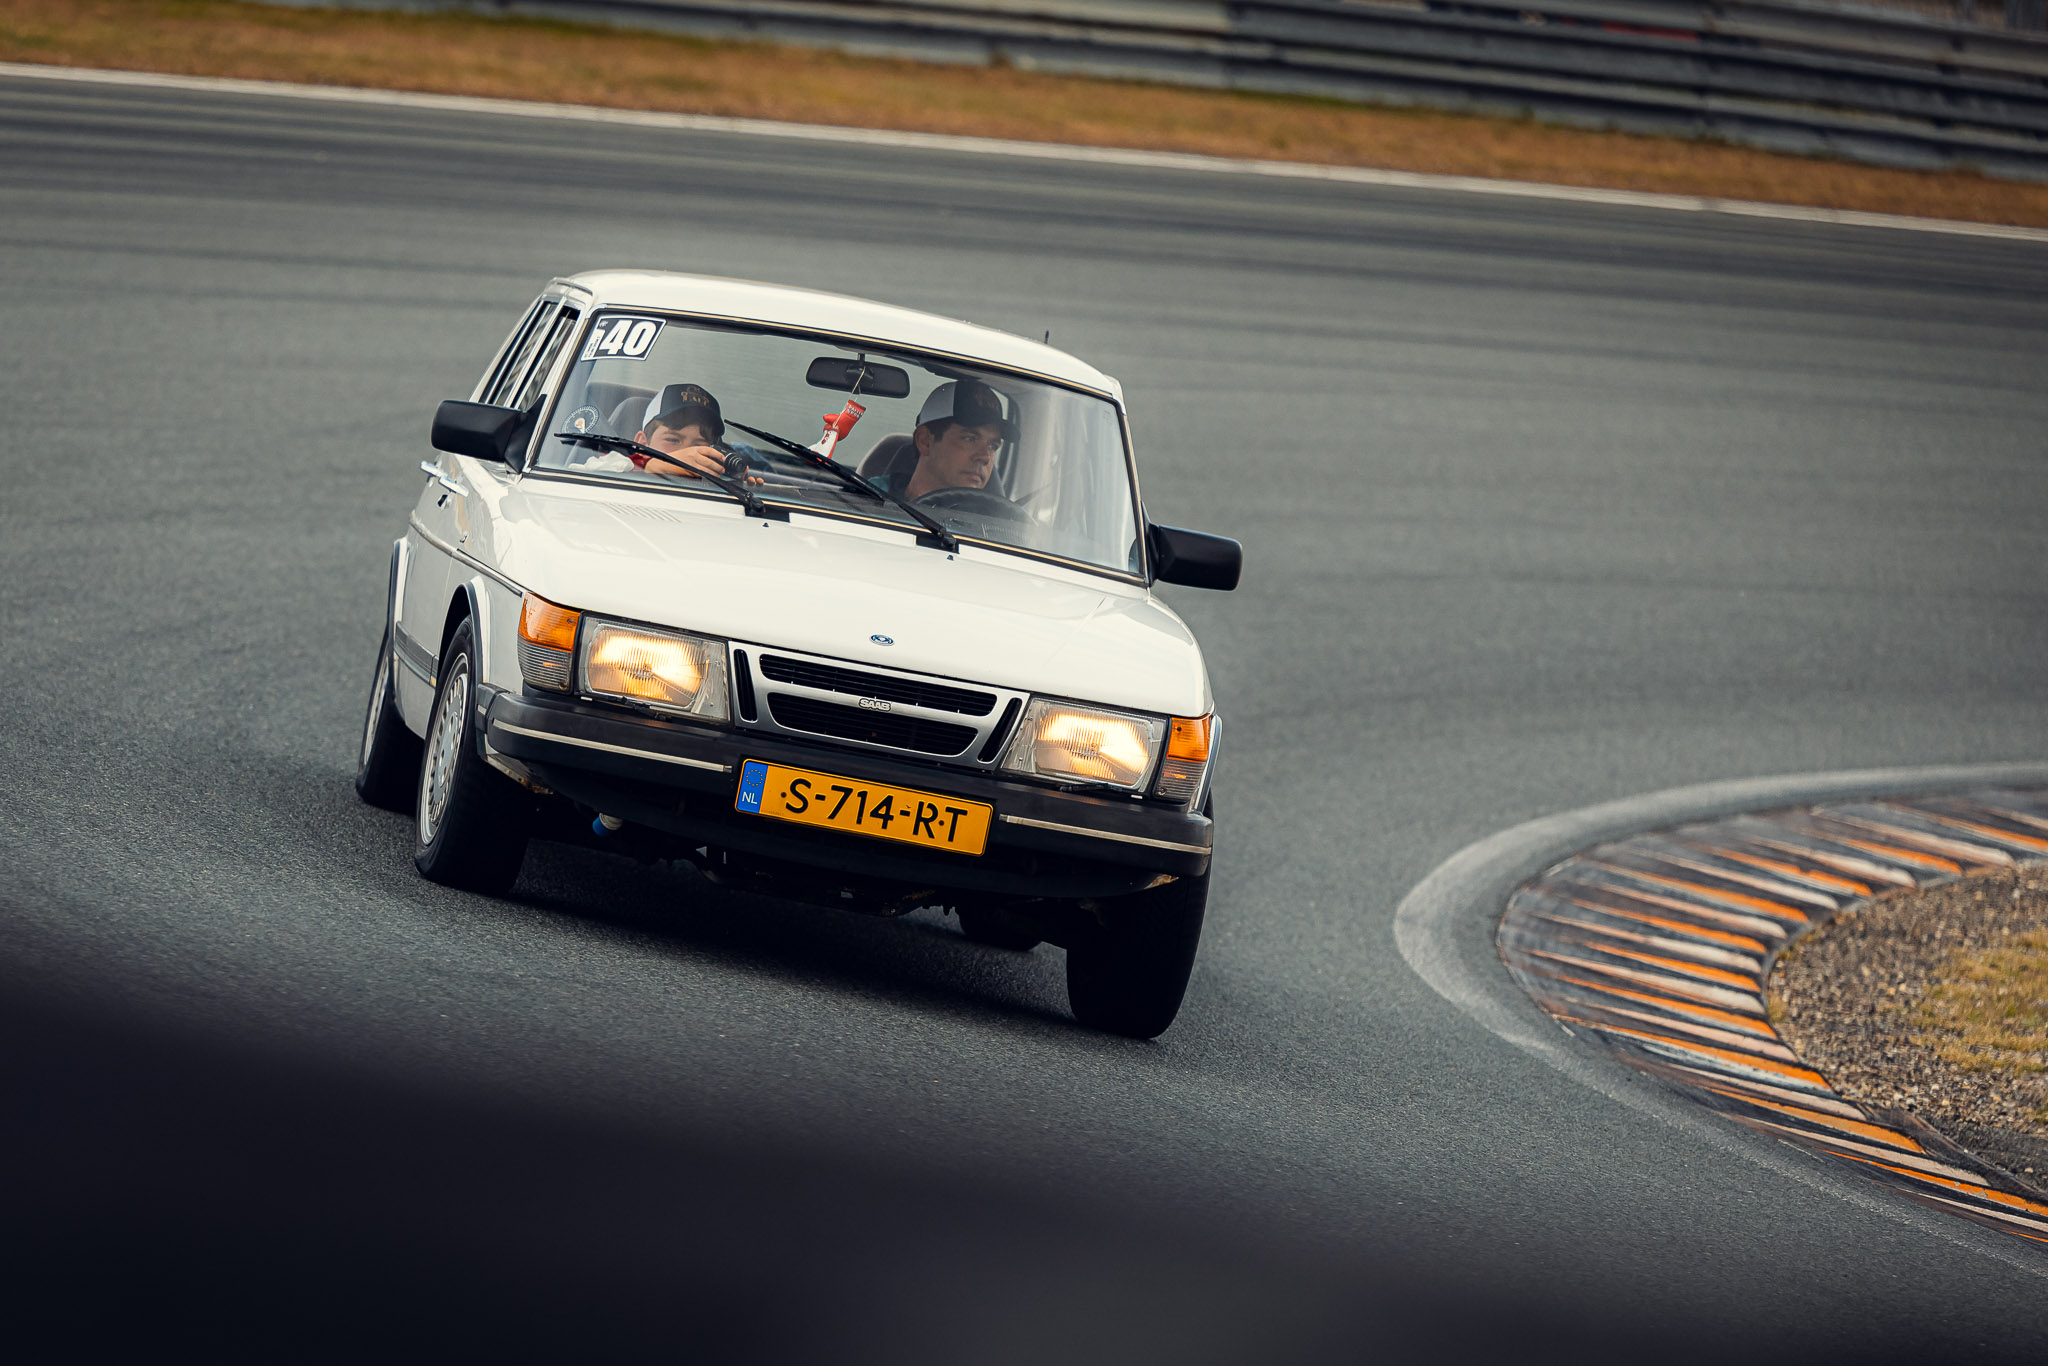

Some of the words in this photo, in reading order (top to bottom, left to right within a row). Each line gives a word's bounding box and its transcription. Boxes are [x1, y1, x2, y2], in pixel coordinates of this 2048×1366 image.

[599, 320, 657, 356] 40
[860, 699, 891, 711] SAAB
[742, 791, 758, 804] NL
[785, 778, 968, 842] S-714-RT
